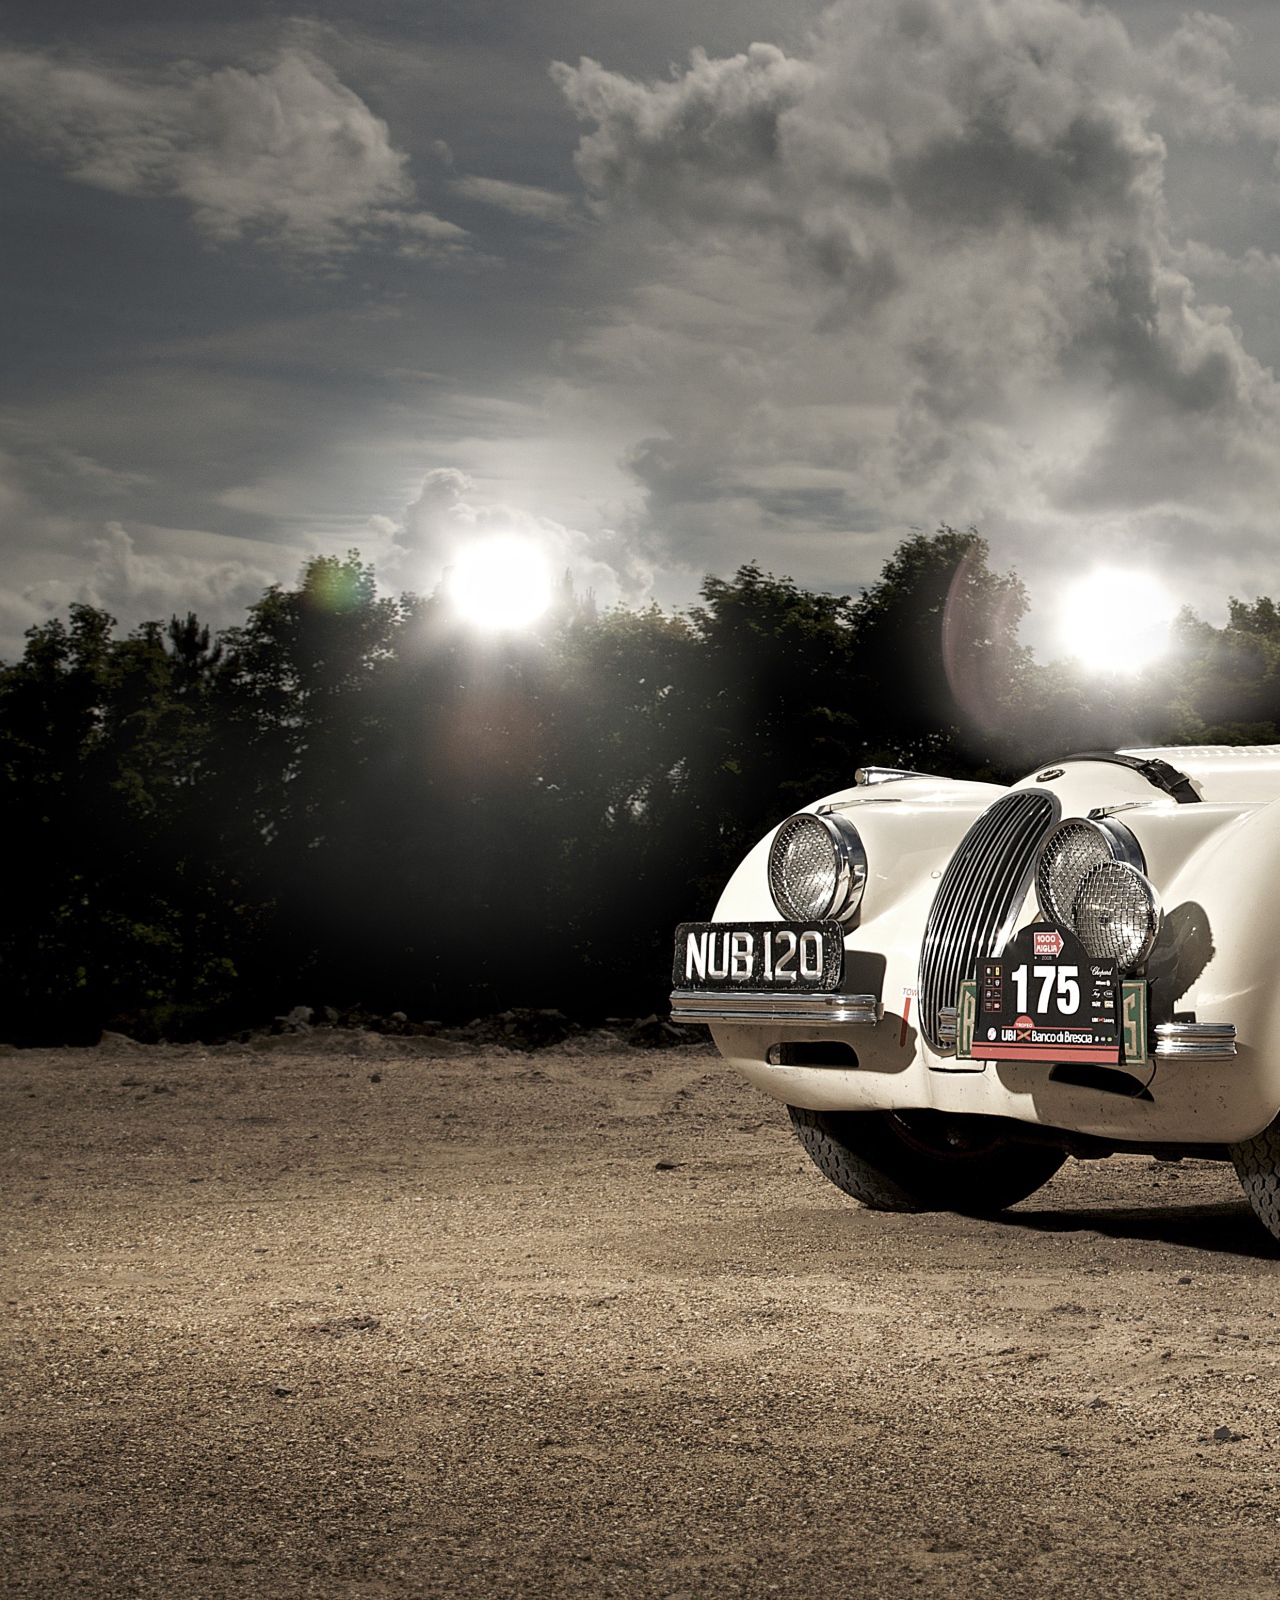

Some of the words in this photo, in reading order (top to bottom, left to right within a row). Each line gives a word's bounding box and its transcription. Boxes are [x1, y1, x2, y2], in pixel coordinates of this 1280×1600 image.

[1037, 935, 1056, 943] 1000
[1036, 944, 1058, 953] MIGLIA
[685, 931, 754, 981] NUB
[763, 931, 823, 981] 120
[1090, 966, 1114, 978] Chopard
[1011, 964, 1081, 1015] 175
[1001, 1029, 1017, 1042] UBI
[1031, 1030, 1056, 1043] Banco
[1056, 1032, 1064, 1043] di
[1064, 1031, 1093, 1044] Brescia
